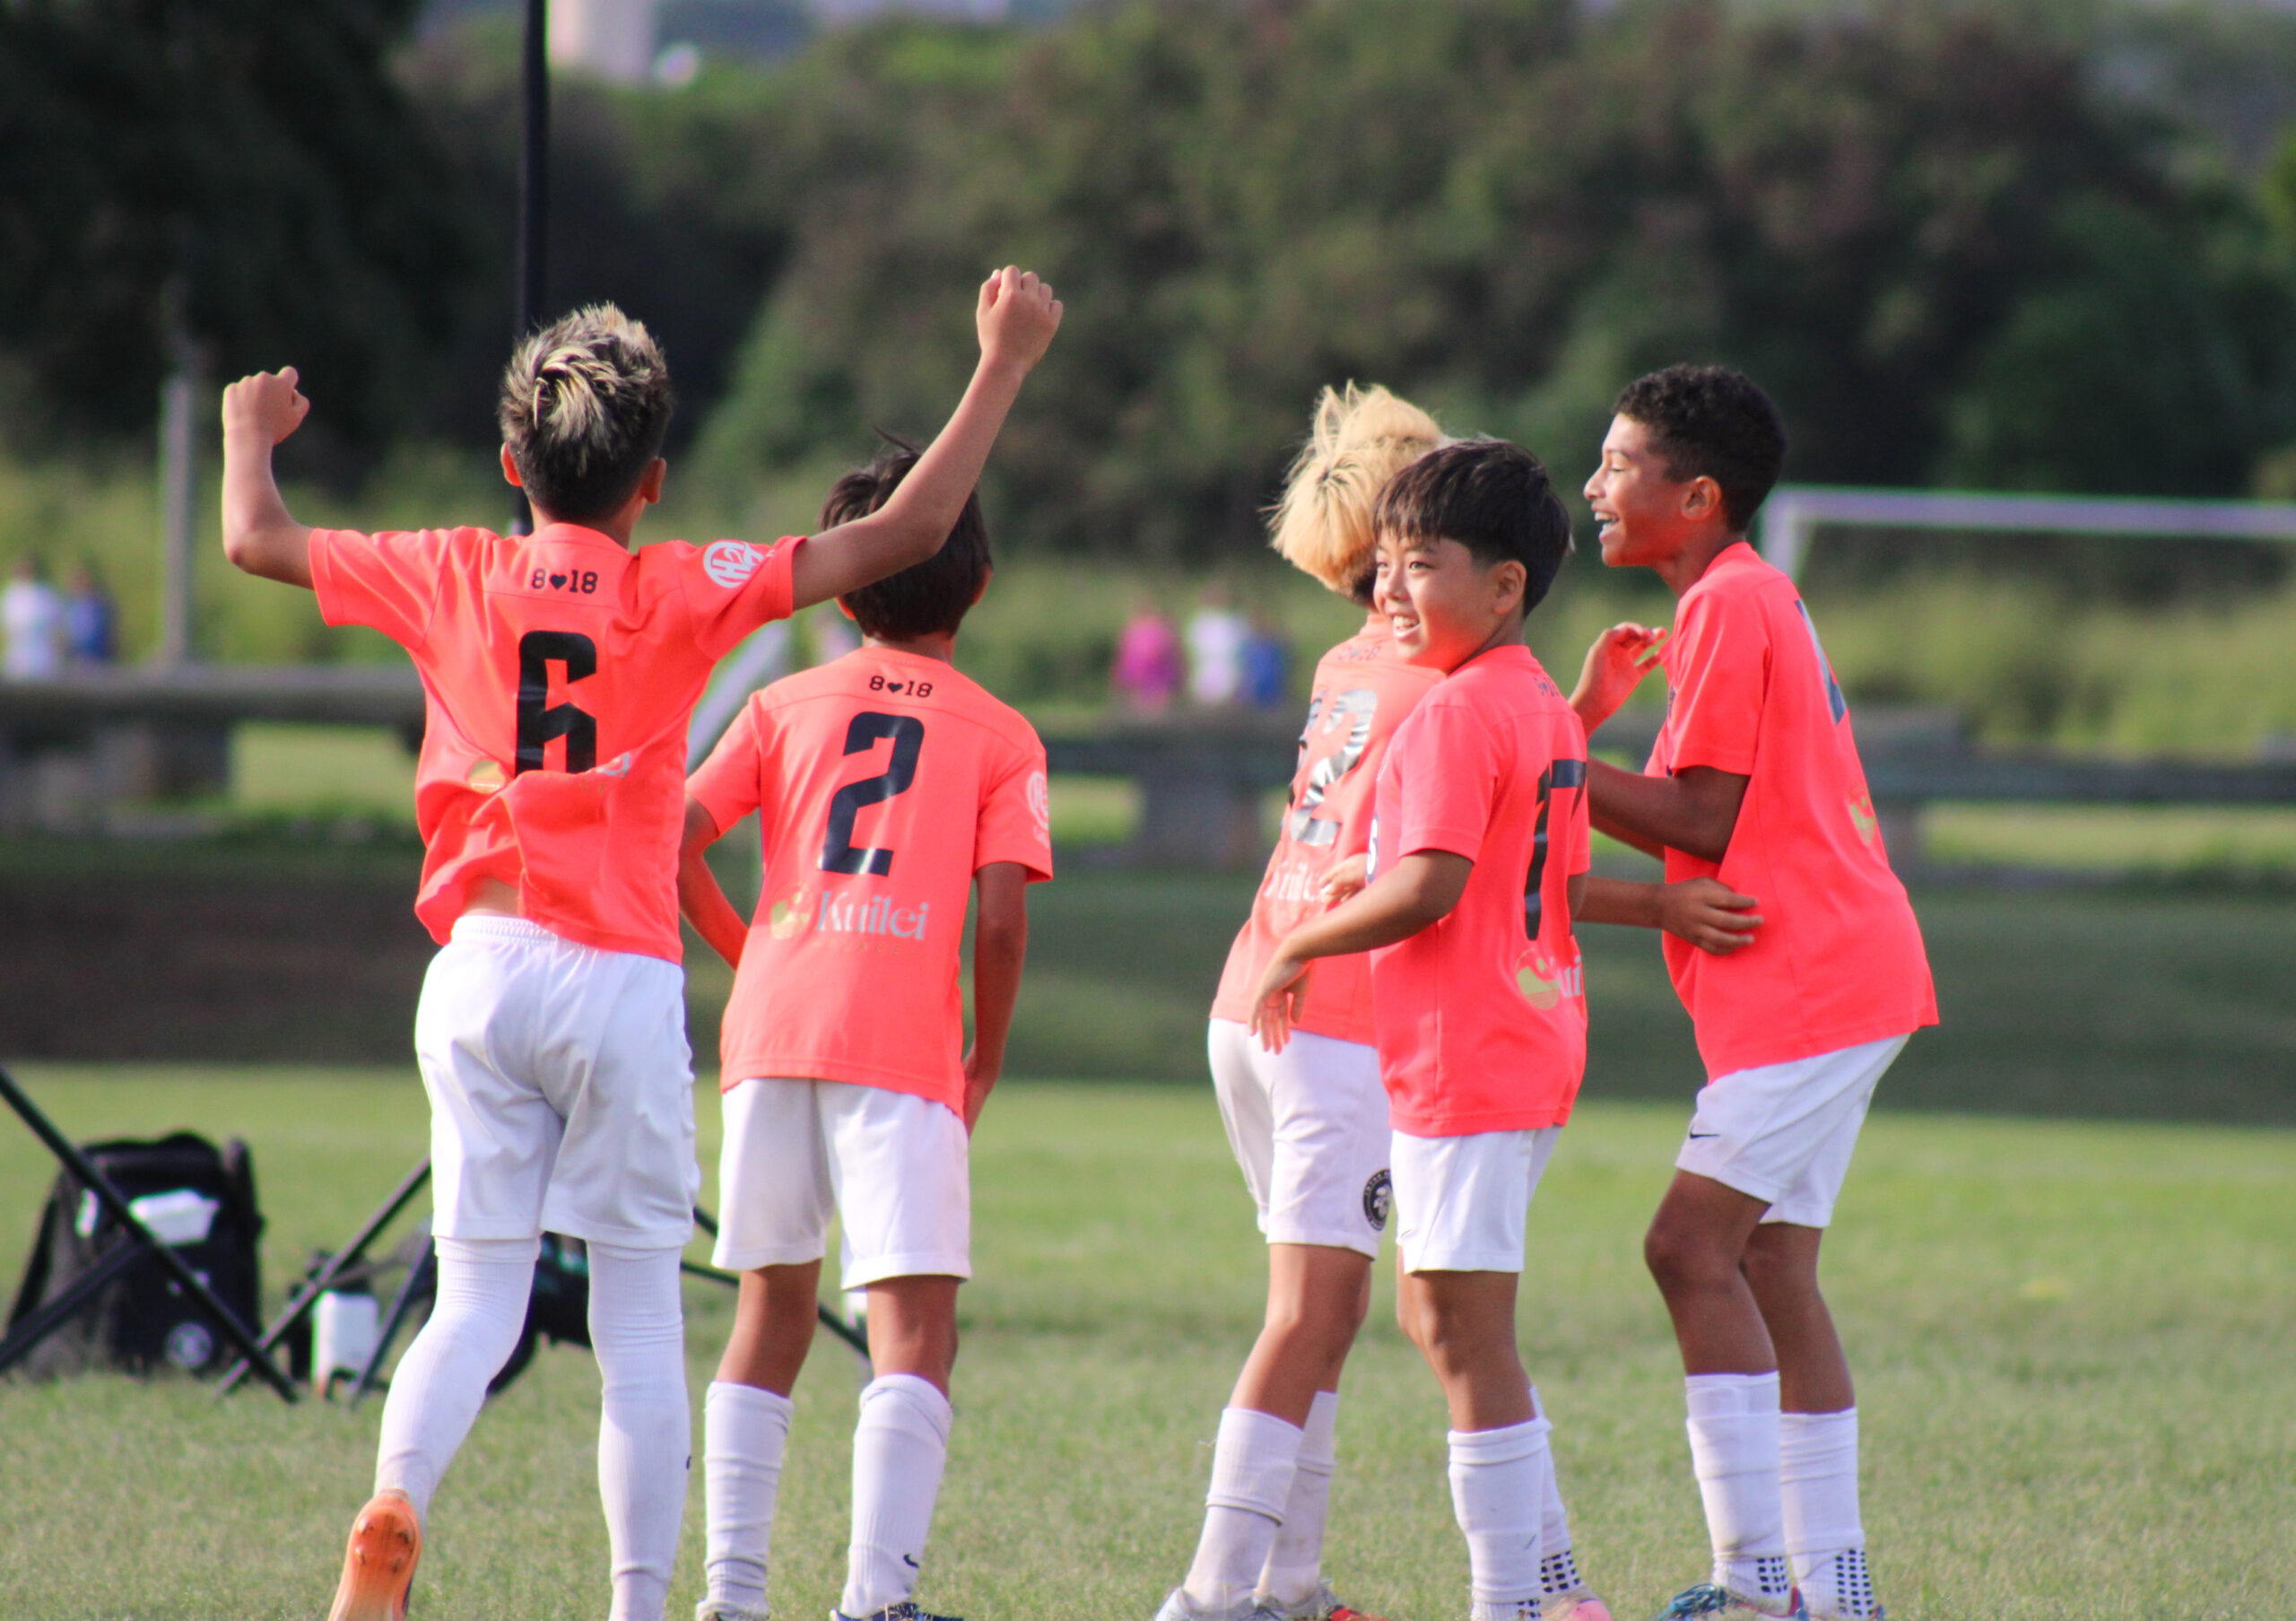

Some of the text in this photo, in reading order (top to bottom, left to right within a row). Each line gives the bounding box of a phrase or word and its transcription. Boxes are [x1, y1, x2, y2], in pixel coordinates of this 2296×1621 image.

[515, 630, 597, 779] 6
[817, 710, 925, 876] 2
[816, 891, 929, 940] Kuilei
